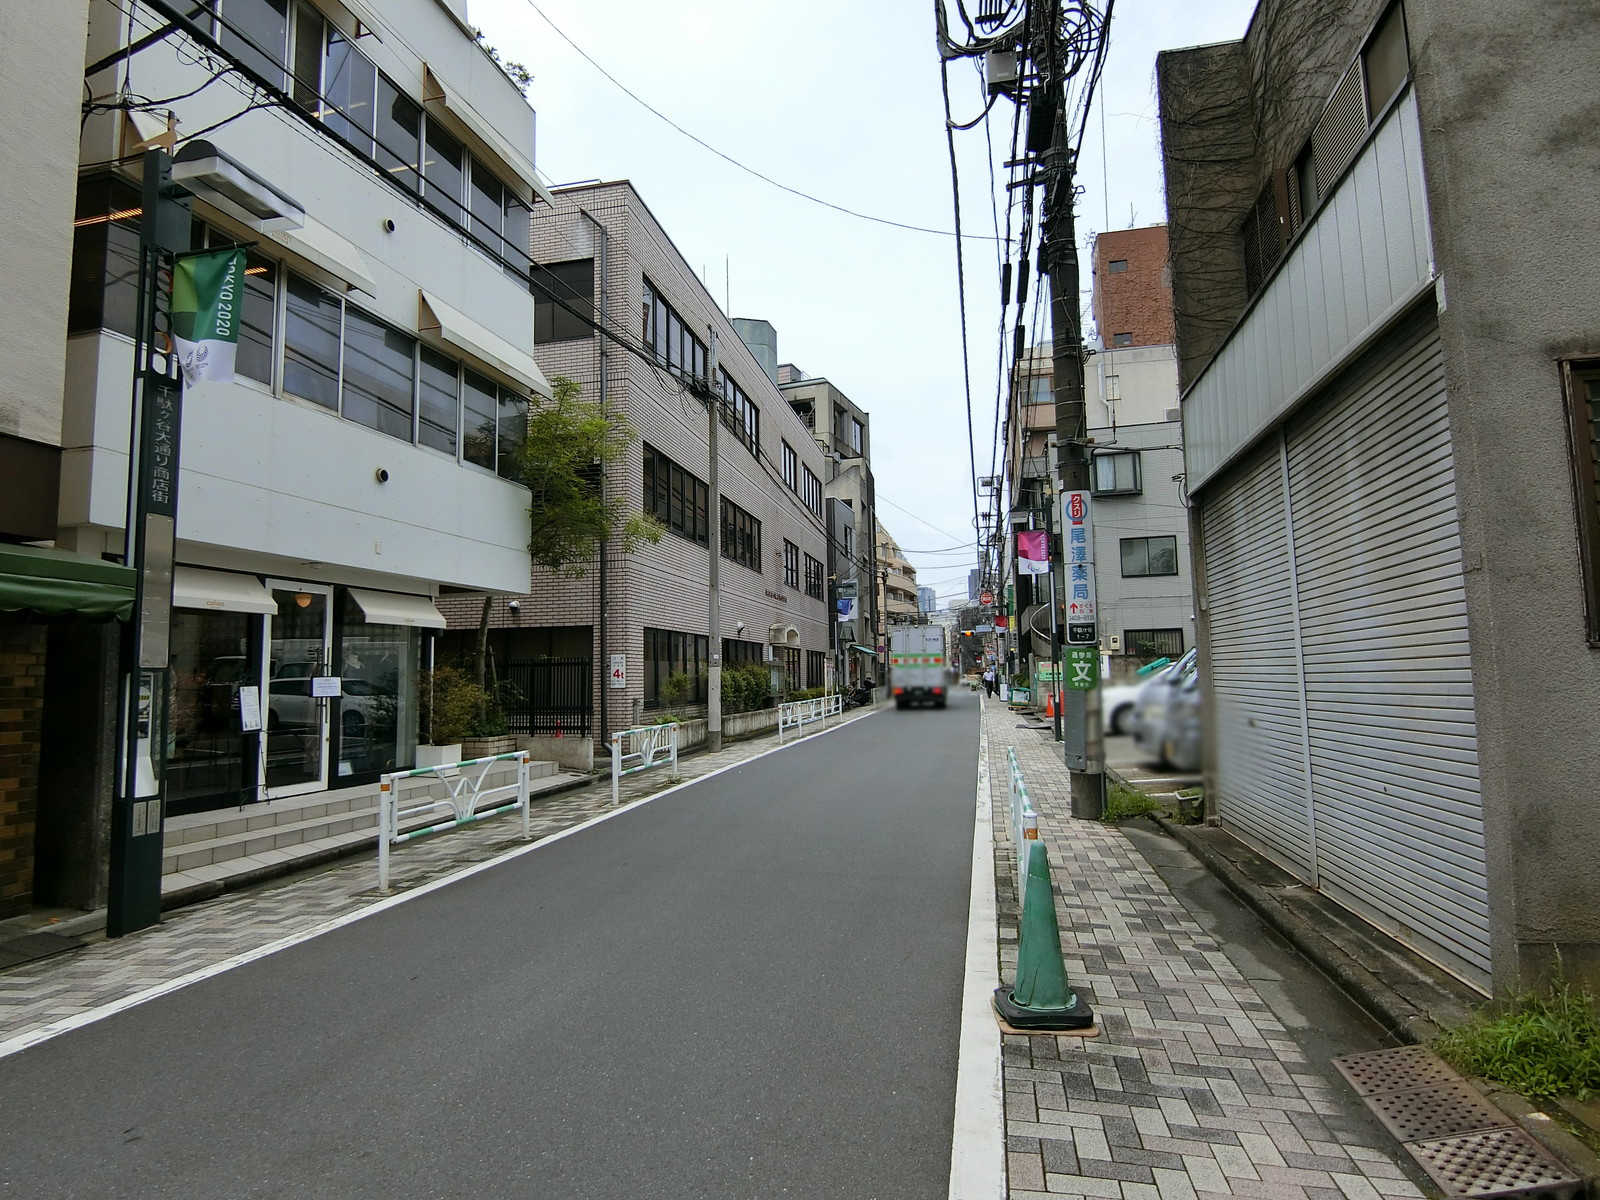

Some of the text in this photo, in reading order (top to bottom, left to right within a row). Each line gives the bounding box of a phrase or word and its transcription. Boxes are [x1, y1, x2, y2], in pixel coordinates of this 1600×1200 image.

[216, 303, 233, 336] 2020
[1073, 495, 1081, 518] クスリ
[1071, 527, 1088, 600] 尾澤薬局
[1072, 661, 1091, 681] 文
